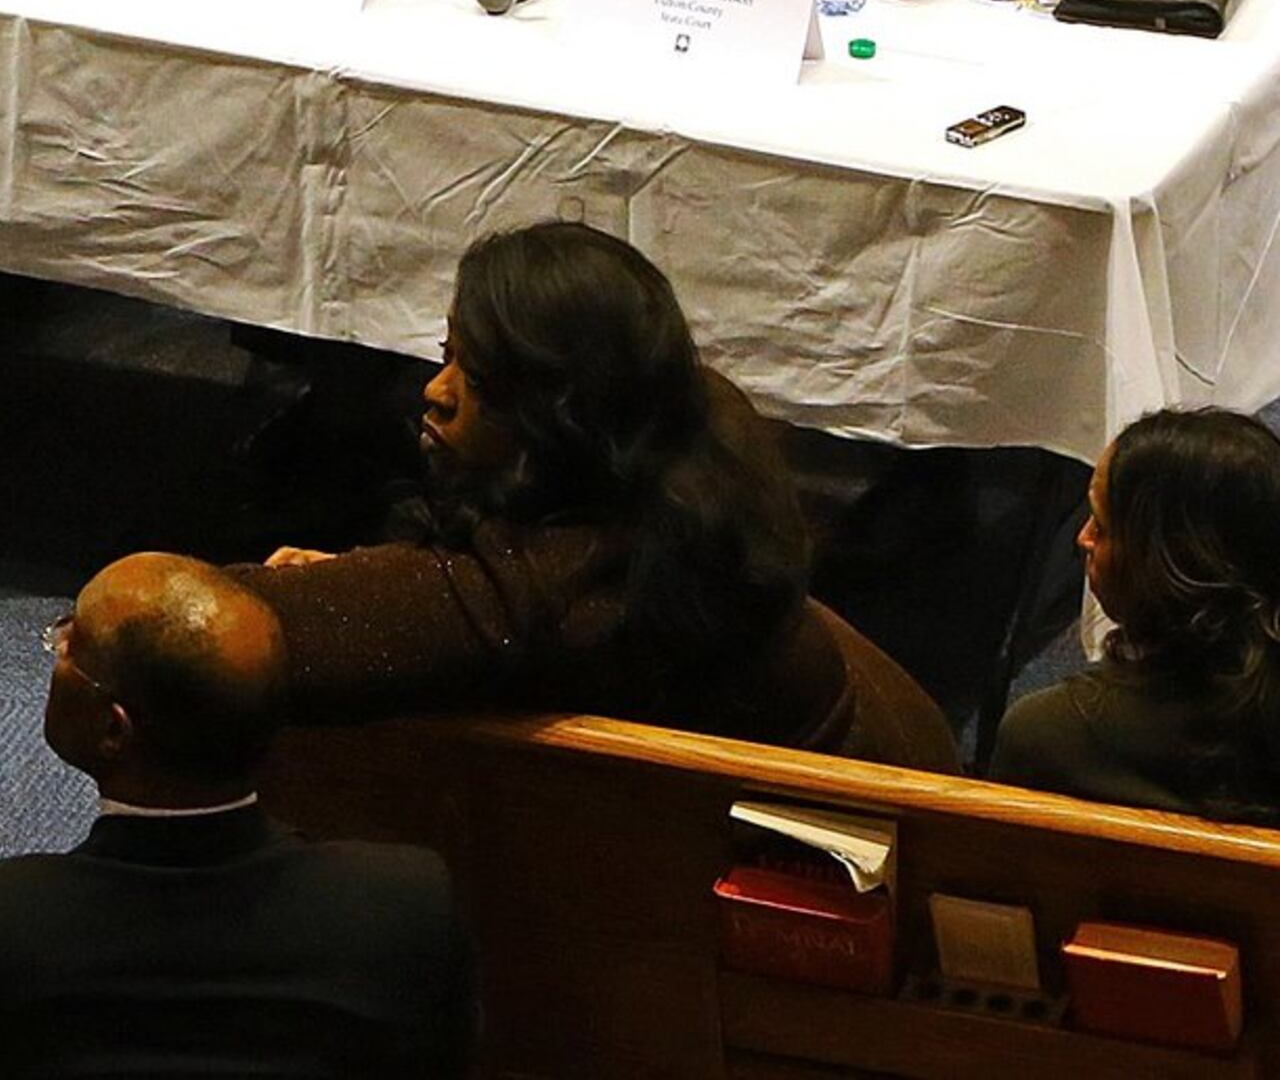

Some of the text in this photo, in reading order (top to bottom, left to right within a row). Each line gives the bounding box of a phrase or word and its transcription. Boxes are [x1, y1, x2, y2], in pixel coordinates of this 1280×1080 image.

[688, 2, 723, 18] County
[661, 12, 712, 29] State Court
